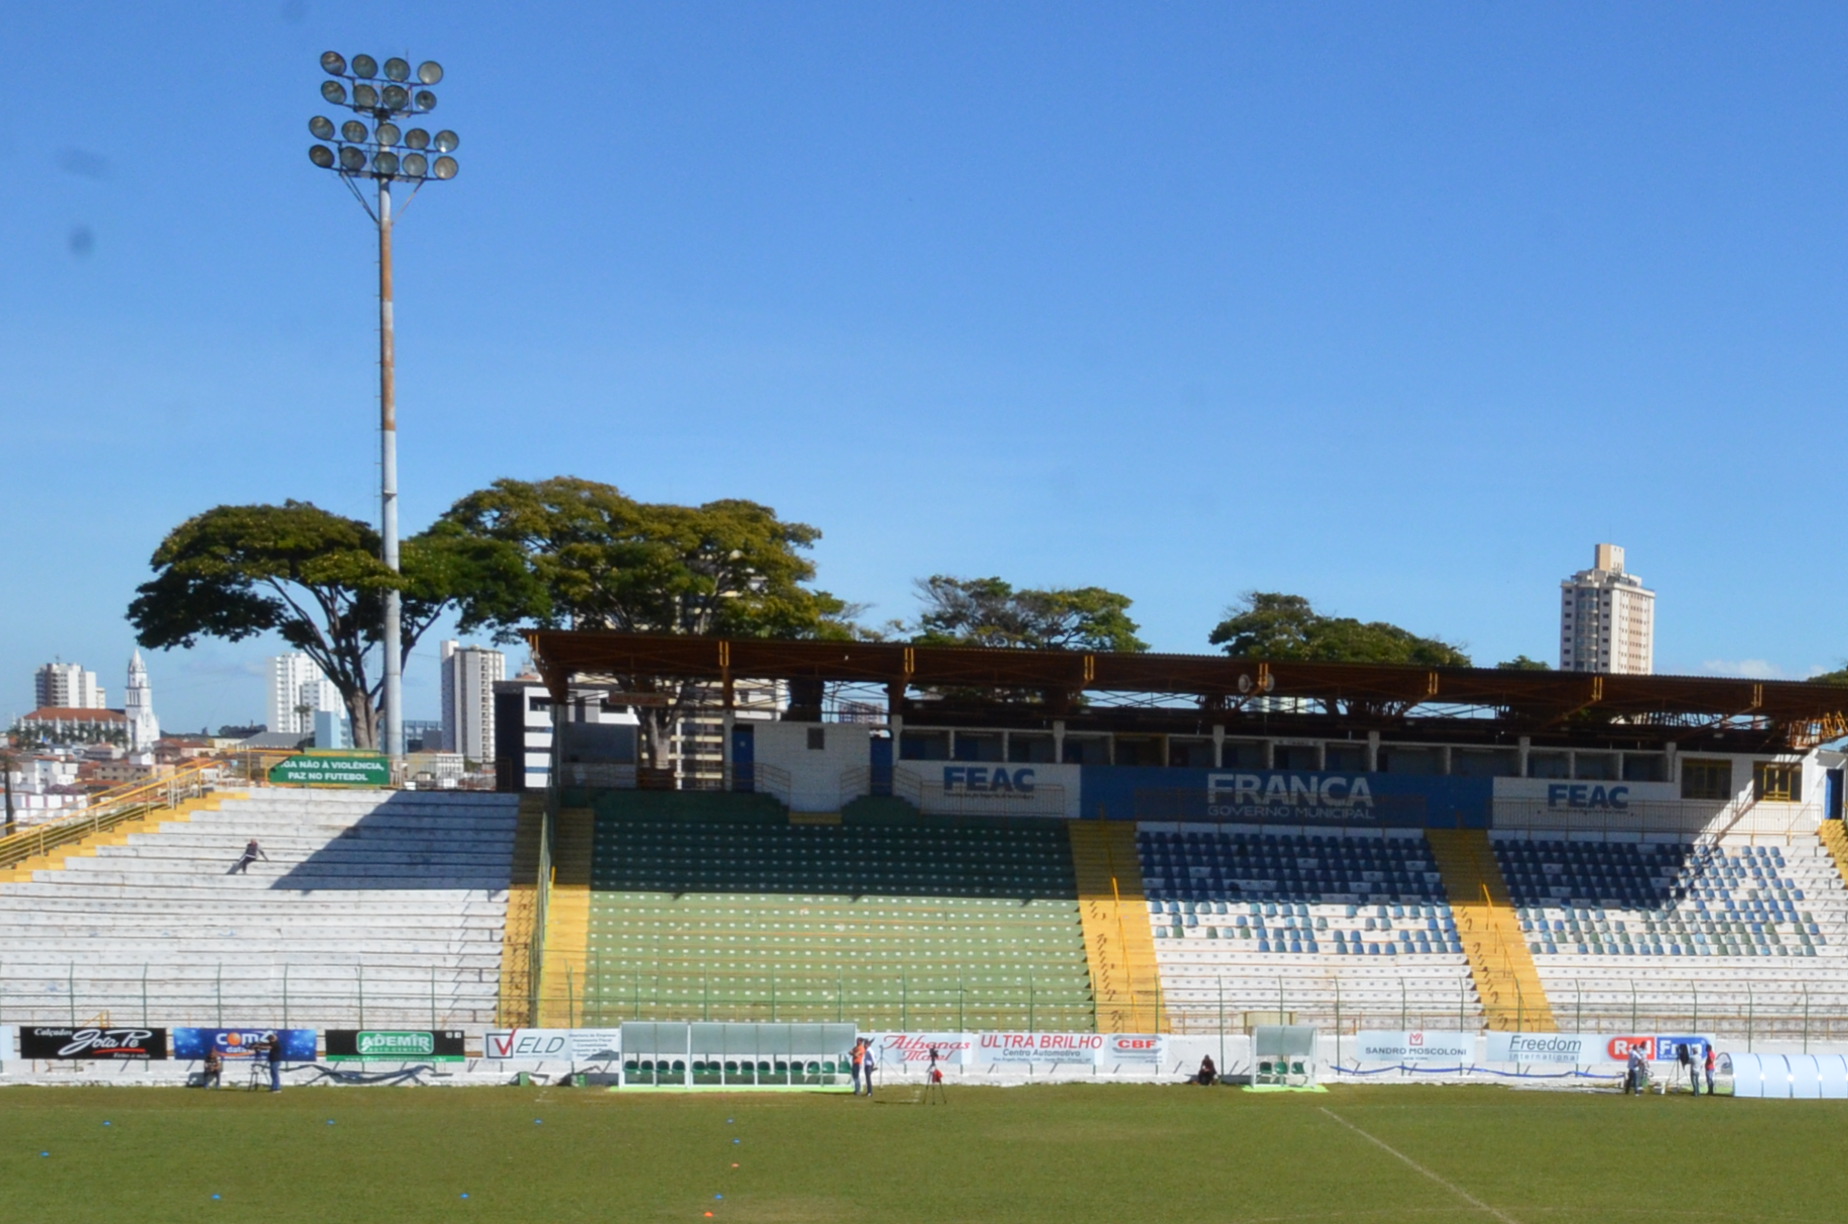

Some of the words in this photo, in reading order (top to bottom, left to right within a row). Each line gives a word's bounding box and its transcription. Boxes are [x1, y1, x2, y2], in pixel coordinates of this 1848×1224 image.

[299, 760, 320, 769] NÃO
[331, 761, 384, 771] VIOLÊNCIA,
[288, 772, 306, 780] PAZ
[325, 773, 368, 781] FUTEBOL
[944, 766, 1034, 792] FEAC
[1207, 773, 1374, 807] FRANCA
[1548, 784, 1629, 809] FEAC
[1208, 805, 1290, 817] GOVERNO
[1295, 807, 1375, 819] MUNICIPAL
[34, 1028, 73, 1037] Calçados
[361, 1034, 430, 1051] ADEMIR
[494, 1029, 565, 1055] VELD
[884, 1035, 970, 1049] Athenas
[981, 1034, 1034, 1048] ULTRA
[1040, 1035, 1103, 1049] BRILHO
[1117, 1039, 1157, 1048] CBF
[1509, 1035, 1582, 1051] Freedom
[1365, 1047, 1407, 1055] SANDRO
[1409, 1047, 1466, 1056] MOSCOLONI
